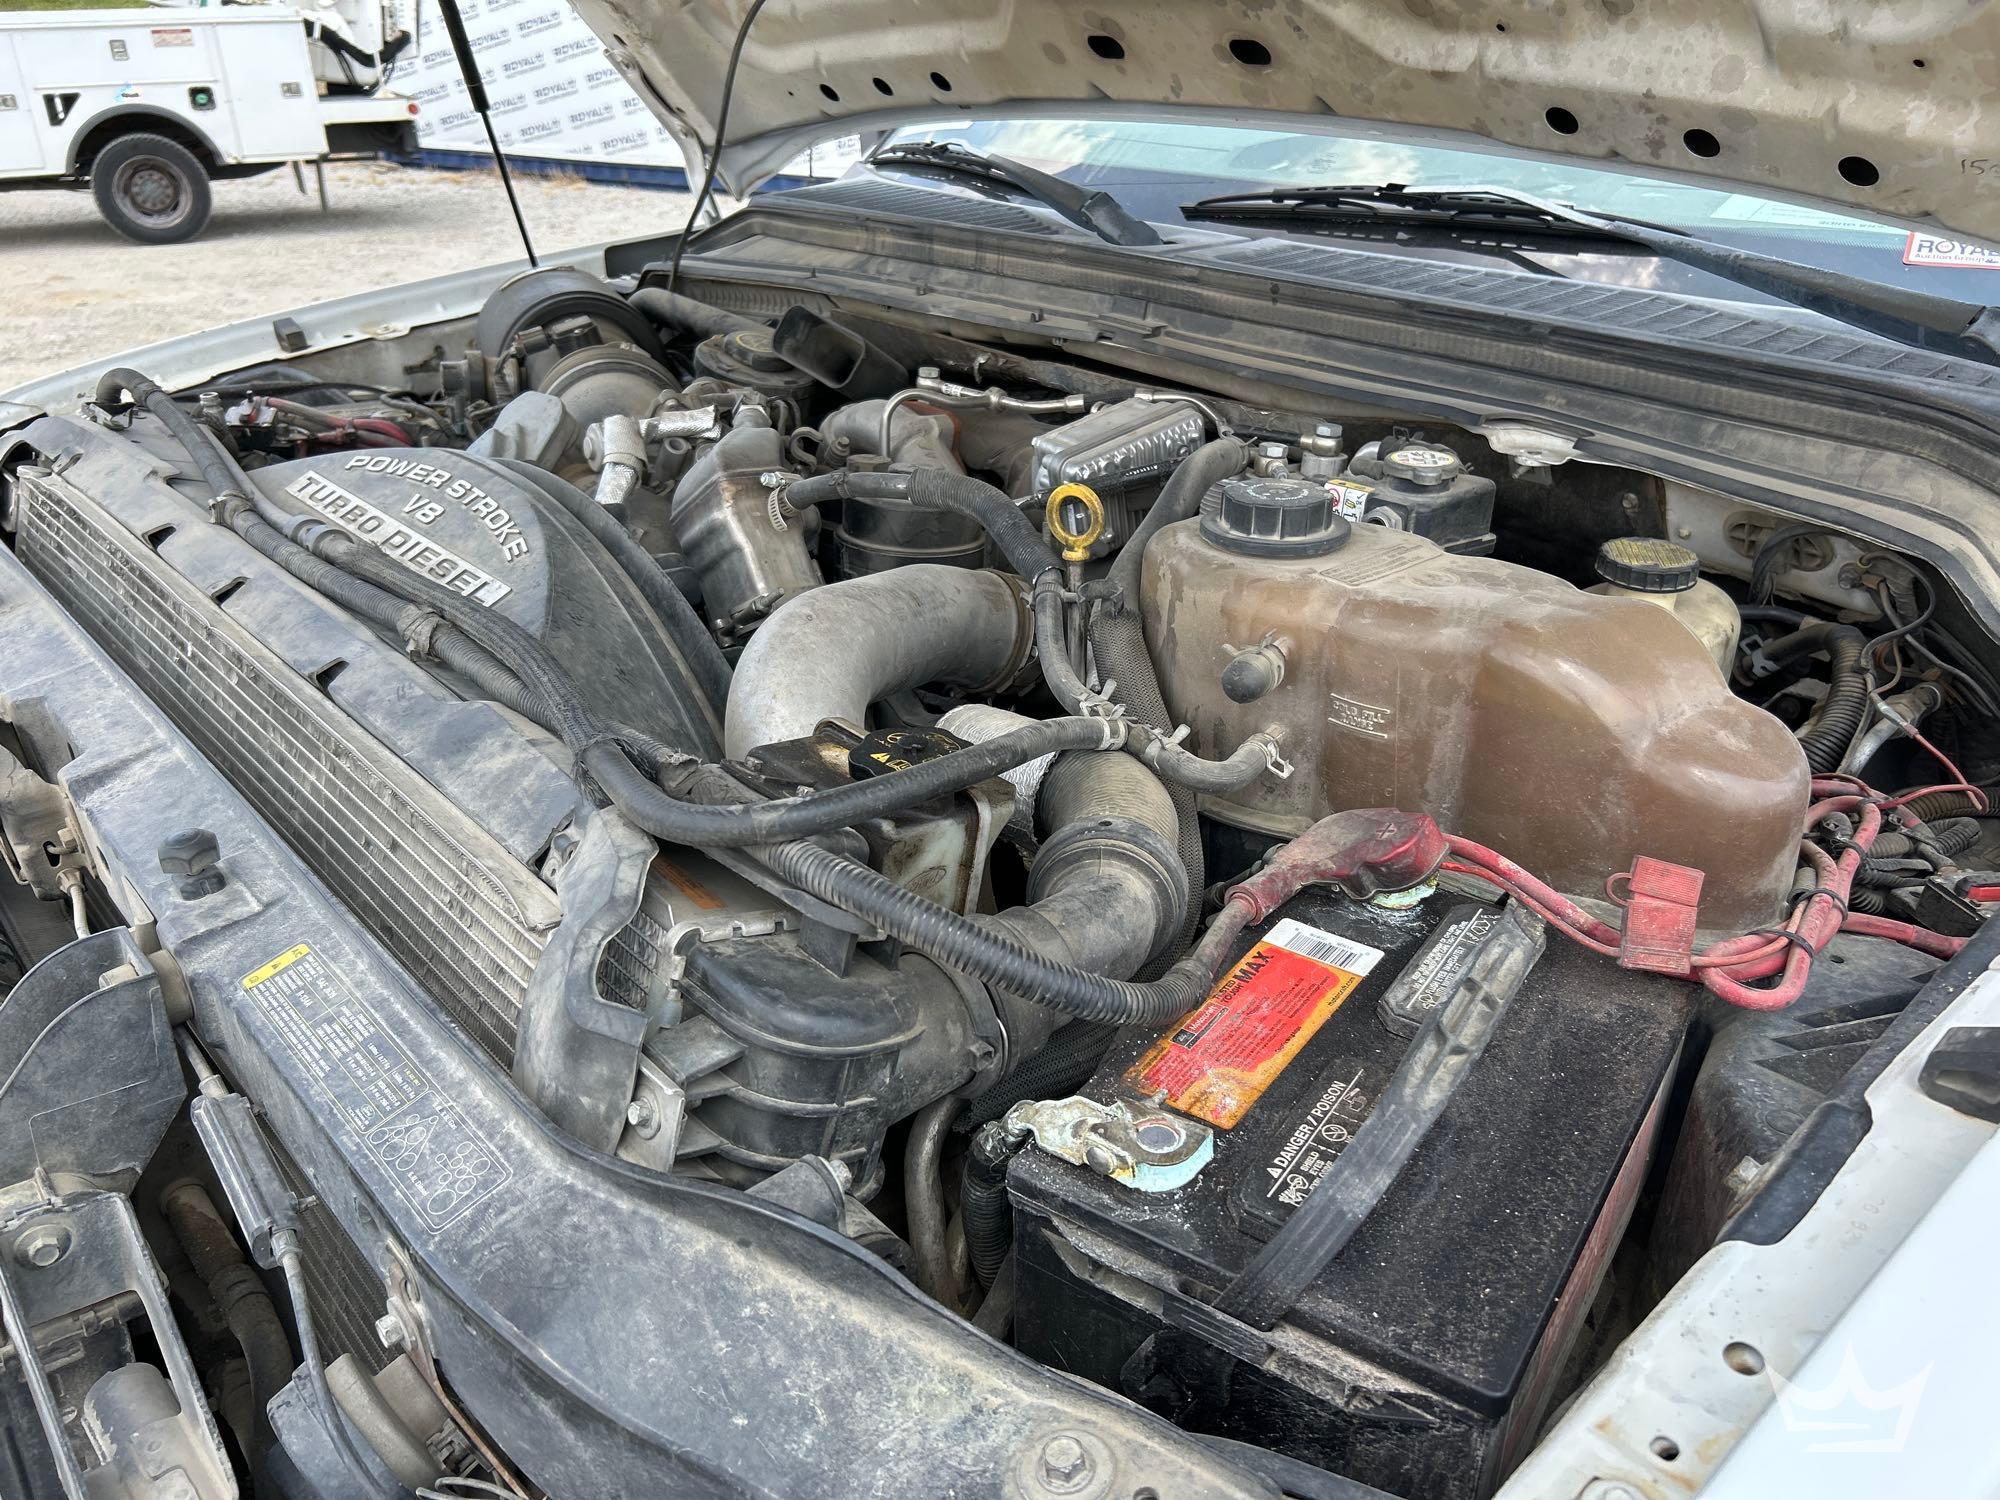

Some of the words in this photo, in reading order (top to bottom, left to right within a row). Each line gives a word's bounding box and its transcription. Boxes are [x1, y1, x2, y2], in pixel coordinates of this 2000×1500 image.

[535, 82, 567, 98] ROYAL
[570, 106, 603, 123] ROYAL
[603, 133, 636, 149] ROYAL
[1954, 255, 1984, 263] Group
[345, 455, 451, 489] POWER
[446, 479, 529, 562] STROKE
[400, 493, 445, 525] V8
[296, 475, 386, 535] TURBO
[384, 533, 491, 607] DIESEL
[1333, 701, 1358, 716] COLD
[1234, 950, 1274, 984] MAX
[317, 977, 328, 989] SAE
[1188, 1005, 1218, 1033] Motorcraft
[1311, 1080, 1347, 1118] POISON
[1306, 1114, 1318, 1127] /
[1274, 1123, 1315, 1168] DANGER
[1300, 1151, 1319, 1171] SHIELD
[1309, 1160, 1324, 1176] EYES
